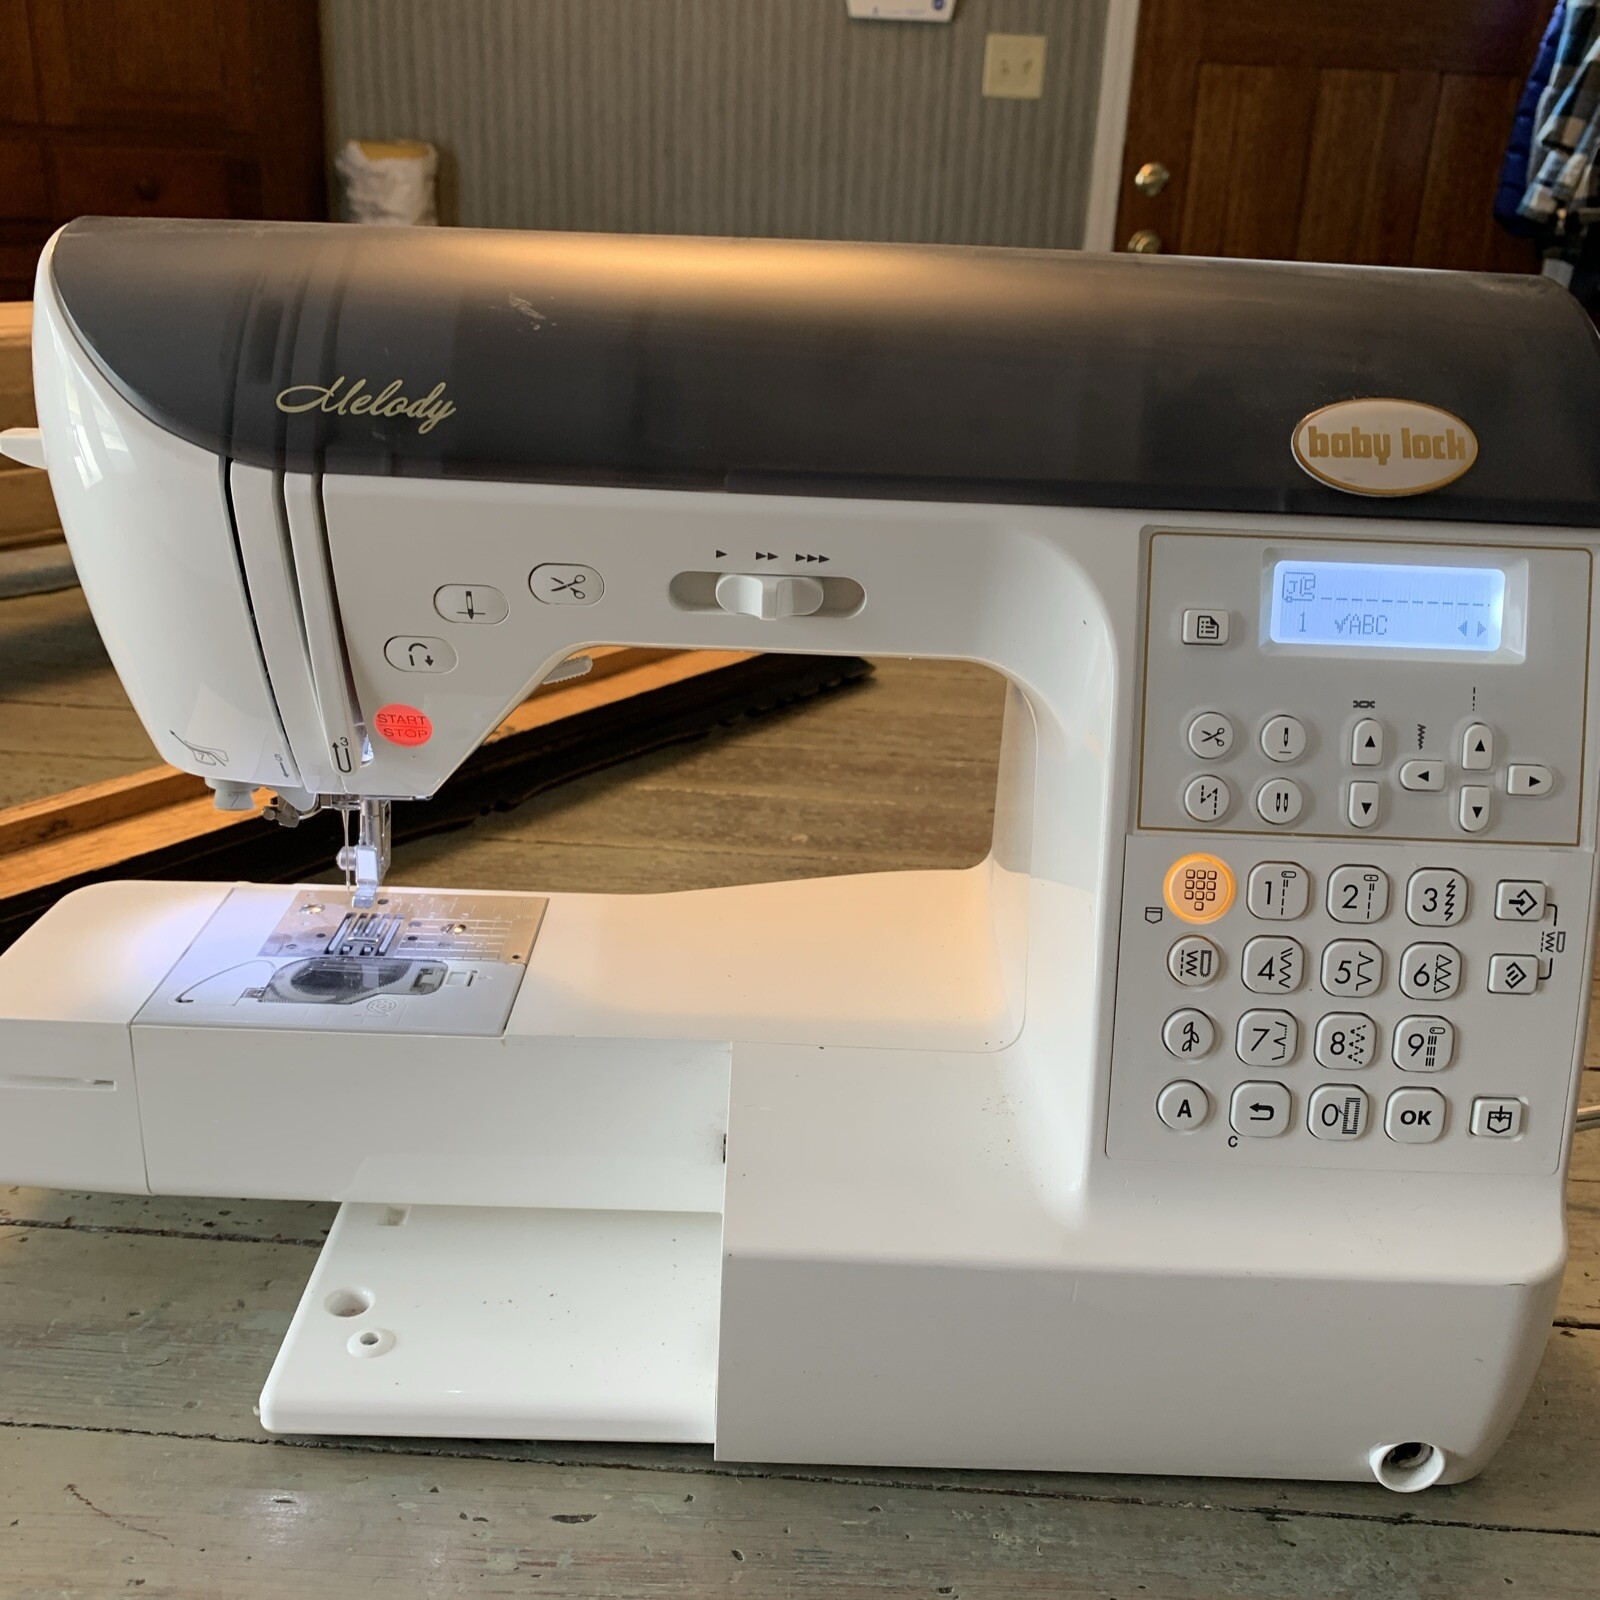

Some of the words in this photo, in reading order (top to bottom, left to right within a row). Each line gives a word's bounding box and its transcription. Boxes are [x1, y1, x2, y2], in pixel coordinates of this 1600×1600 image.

[275, 375, 457, 435] Melody
[1308, 425, 1391, 466] baby
[1401, 427, 1467, 460] lock
[1299, 612, 1306, 632] 1
[377, 713, 427, 725] START
[340, 736, 349, 746] 3
[383, 728, 428, 738] STOP
[1264, 880, 1272, 905] 1
[1341, 884, 1359, 909] 2
[1422, 887, 1438, 912] 3
[1257, 956, 1275, 980] 4
[1334, 960, 1352, 984] 5
[1413, 963, 1430, 987] 6
[1250, 1028, 1270, 1051] 7
[1330, 1031, 1346, 1055] 8
[1407, 1033, 1425, 1057] 9
[1176, 1099, 1192, 1118] A
[1400, 1110, 1432, 1126] OK
[1227, 1135, 1238, 1148] C
